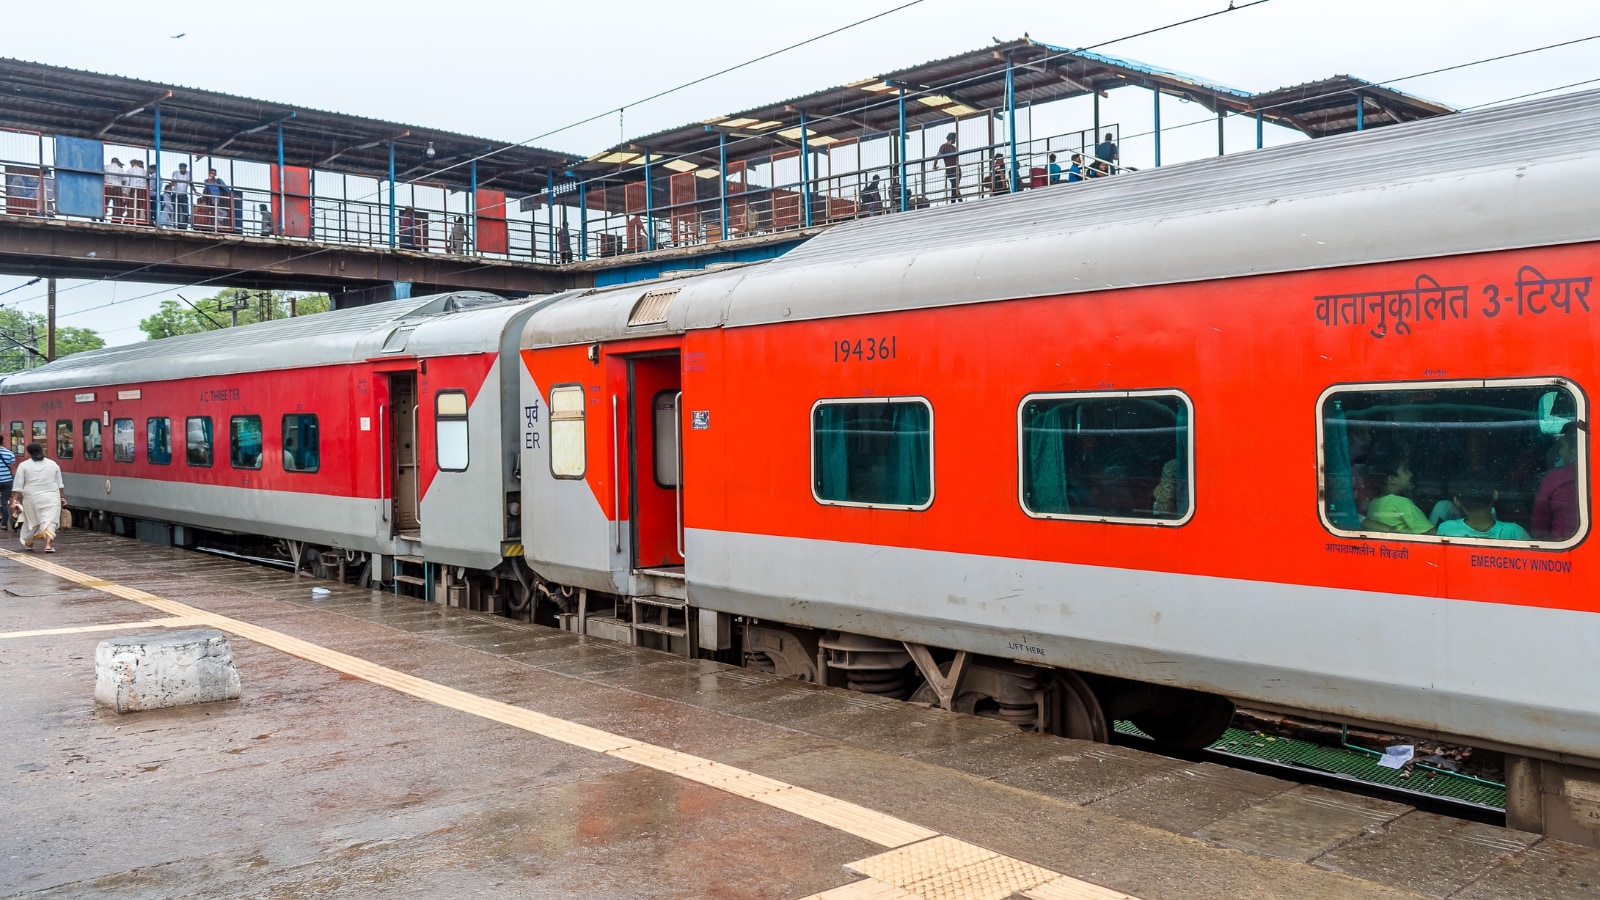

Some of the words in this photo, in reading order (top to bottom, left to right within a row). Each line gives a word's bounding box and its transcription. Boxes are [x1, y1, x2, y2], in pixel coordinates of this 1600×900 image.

[1314, 273, 1469, 339] वातानुकूलित
[1482, 265, 1593, 318] 3-टियर
[834, 335, 896, 363] 194361
[525, 399, 538, 428] पूर्व
[525, 432, 541, 449] ER
[1325, 543, 1375, 557] आपातकालीन
[1471, 555, 1527, 570] EMERGENCY
[1530, 559, 1571, 573] WINDOW
[1008, 641, 1023, 651] LIFT
[1025, 645, 1046, 656] HERE
